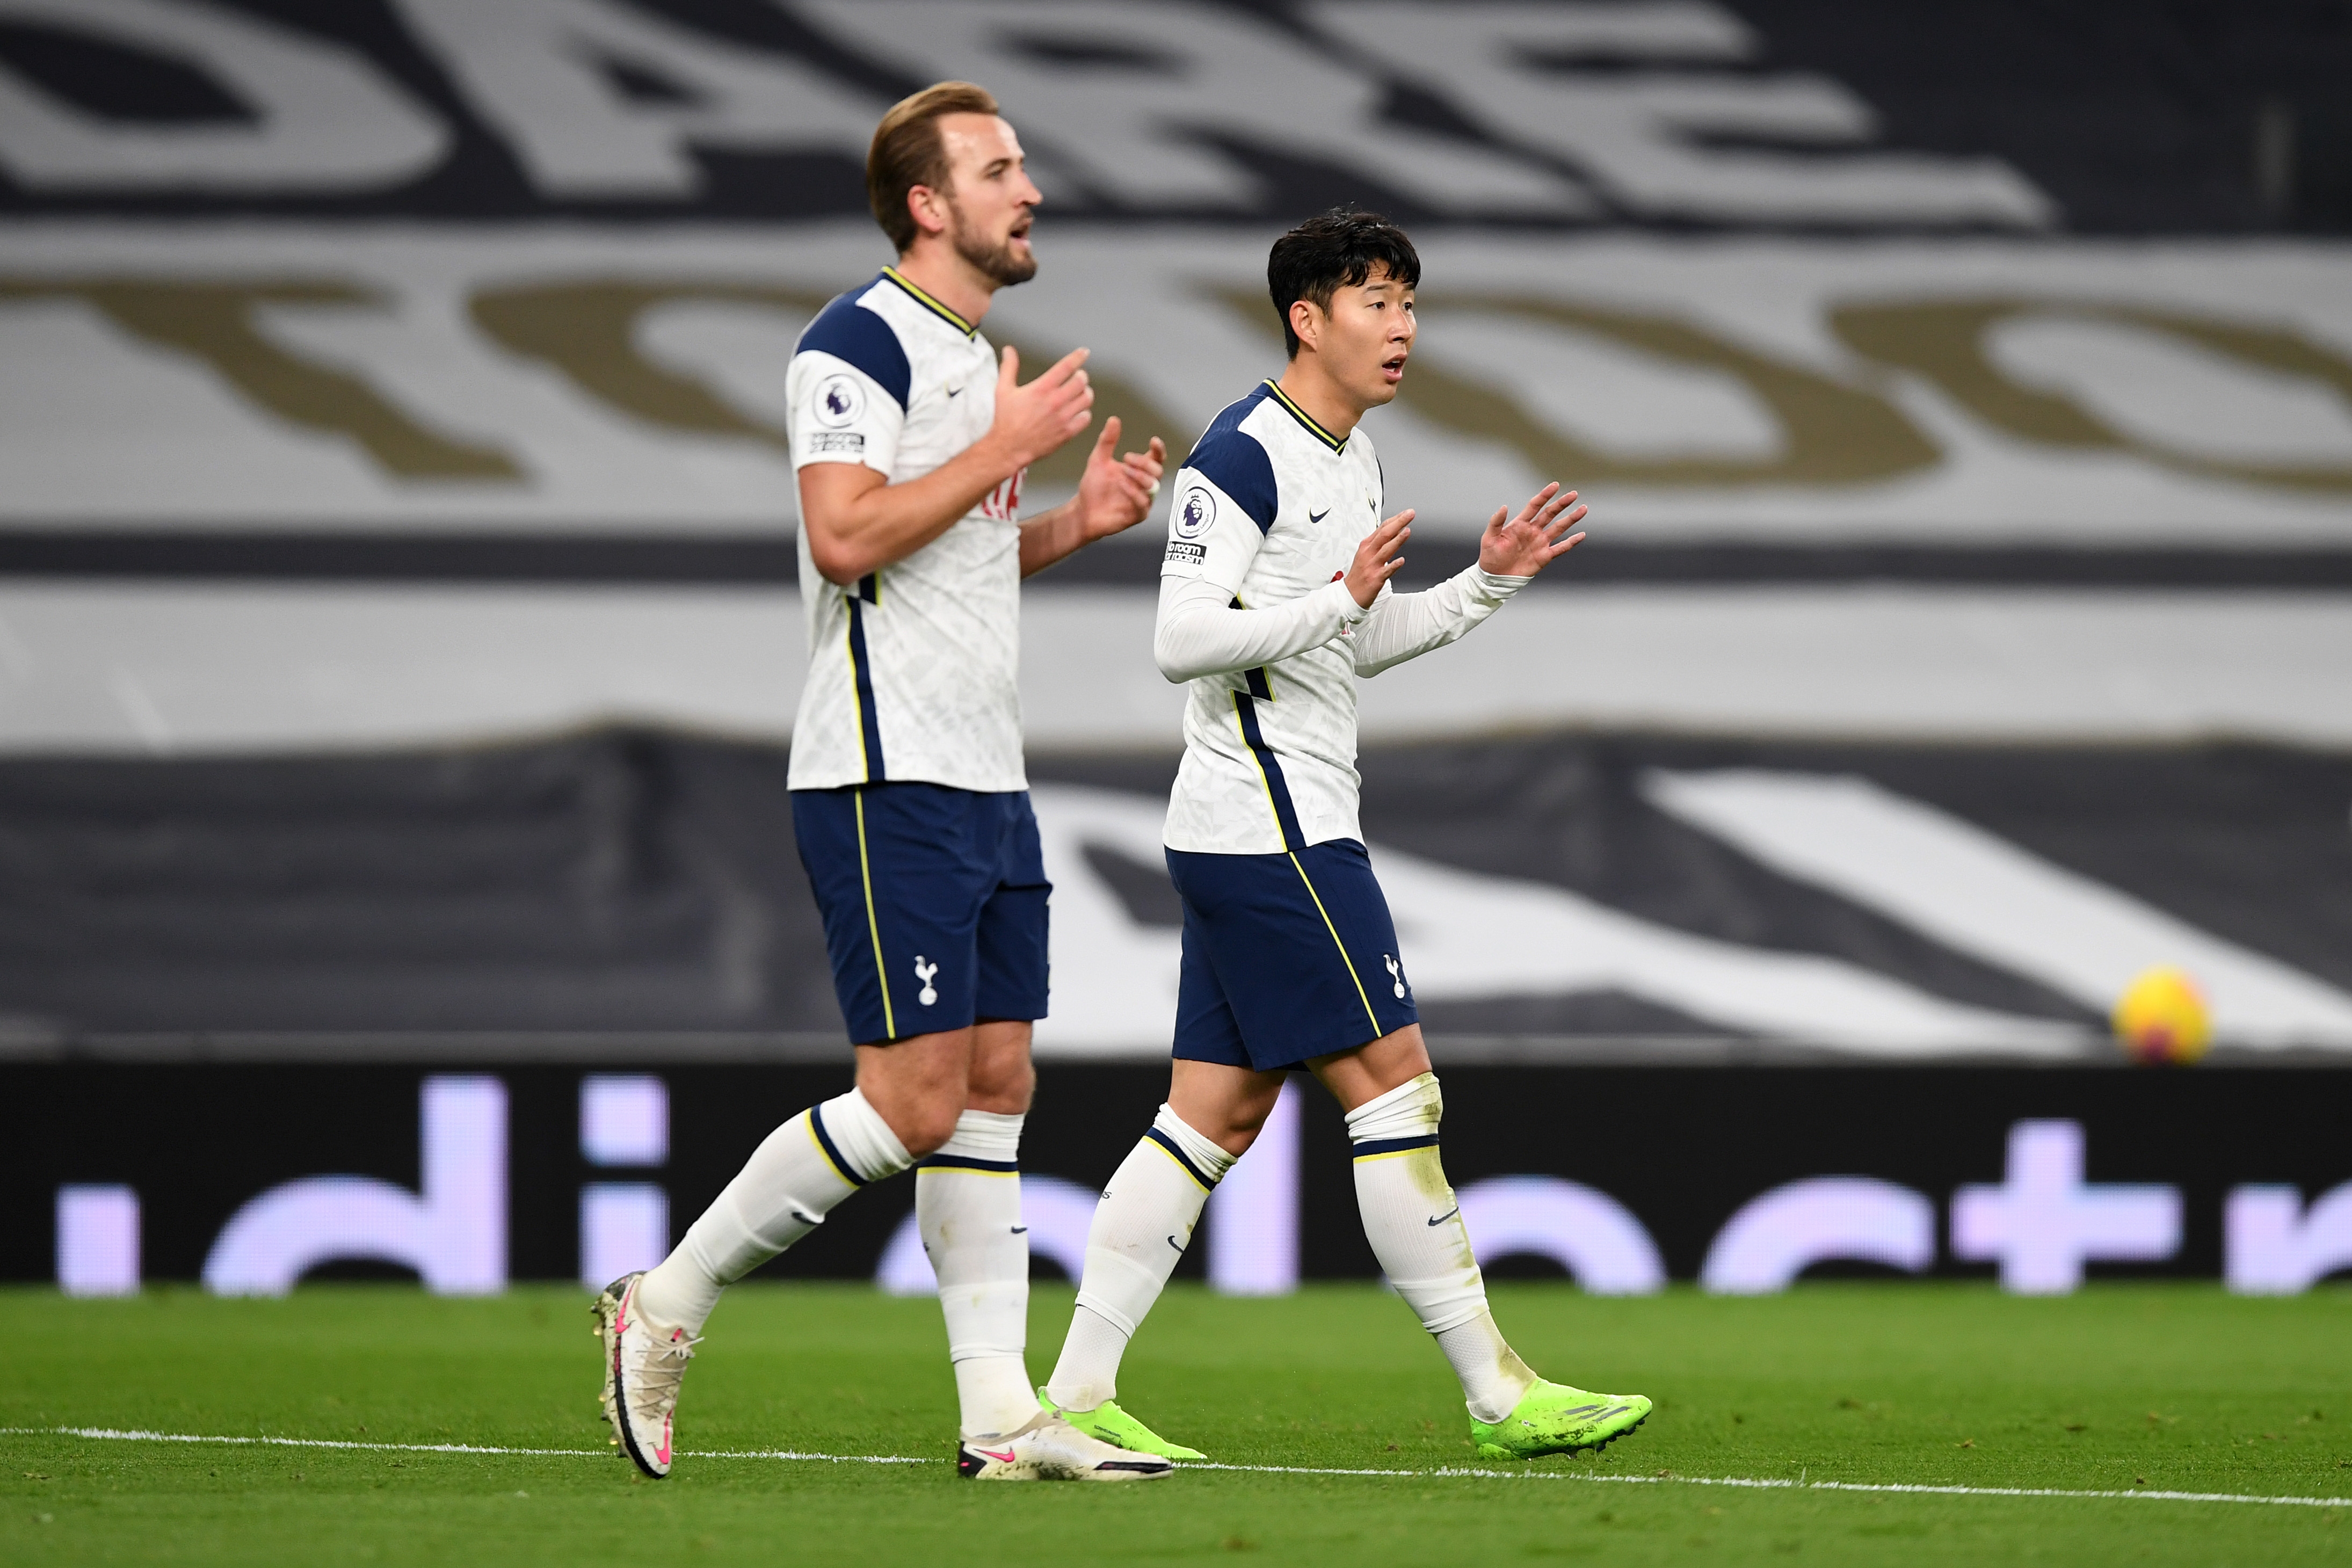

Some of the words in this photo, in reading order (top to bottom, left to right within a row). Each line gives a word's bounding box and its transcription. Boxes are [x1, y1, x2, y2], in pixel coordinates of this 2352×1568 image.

[0, 0, 2062, 228] DARE
[1174, 543, 1201, 556] room
[1171, 552, 1204, 565] racism
